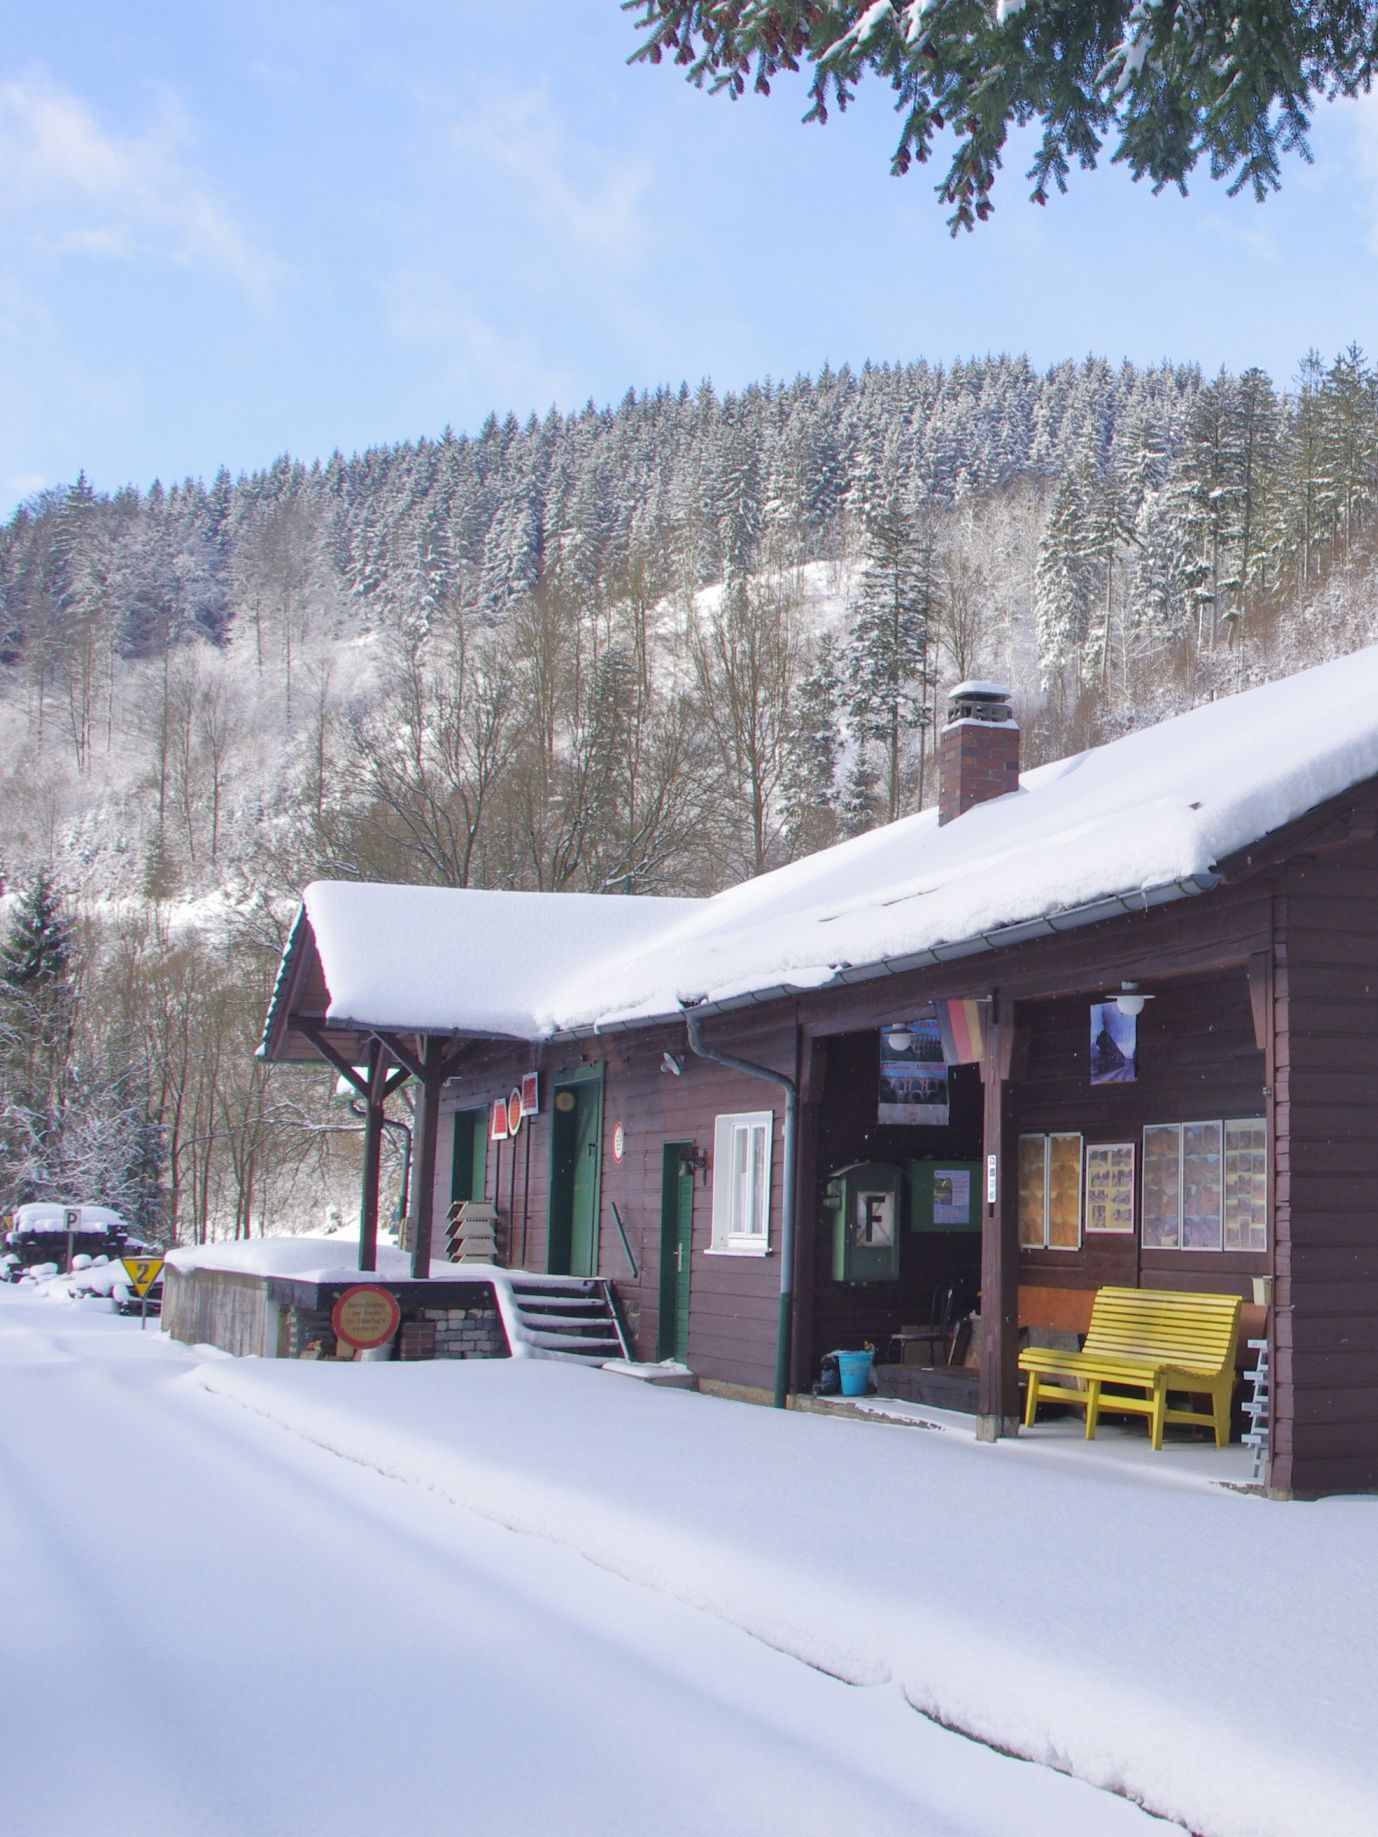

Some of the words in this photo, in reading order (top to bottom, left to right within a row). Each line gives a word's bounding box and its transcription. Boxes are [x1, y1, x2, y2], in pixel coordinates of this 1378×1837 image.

[67, 1212, 78, 1229] P
[866, 1196, 886, 1242] F
[136, 1263, 149, 1284] 2
